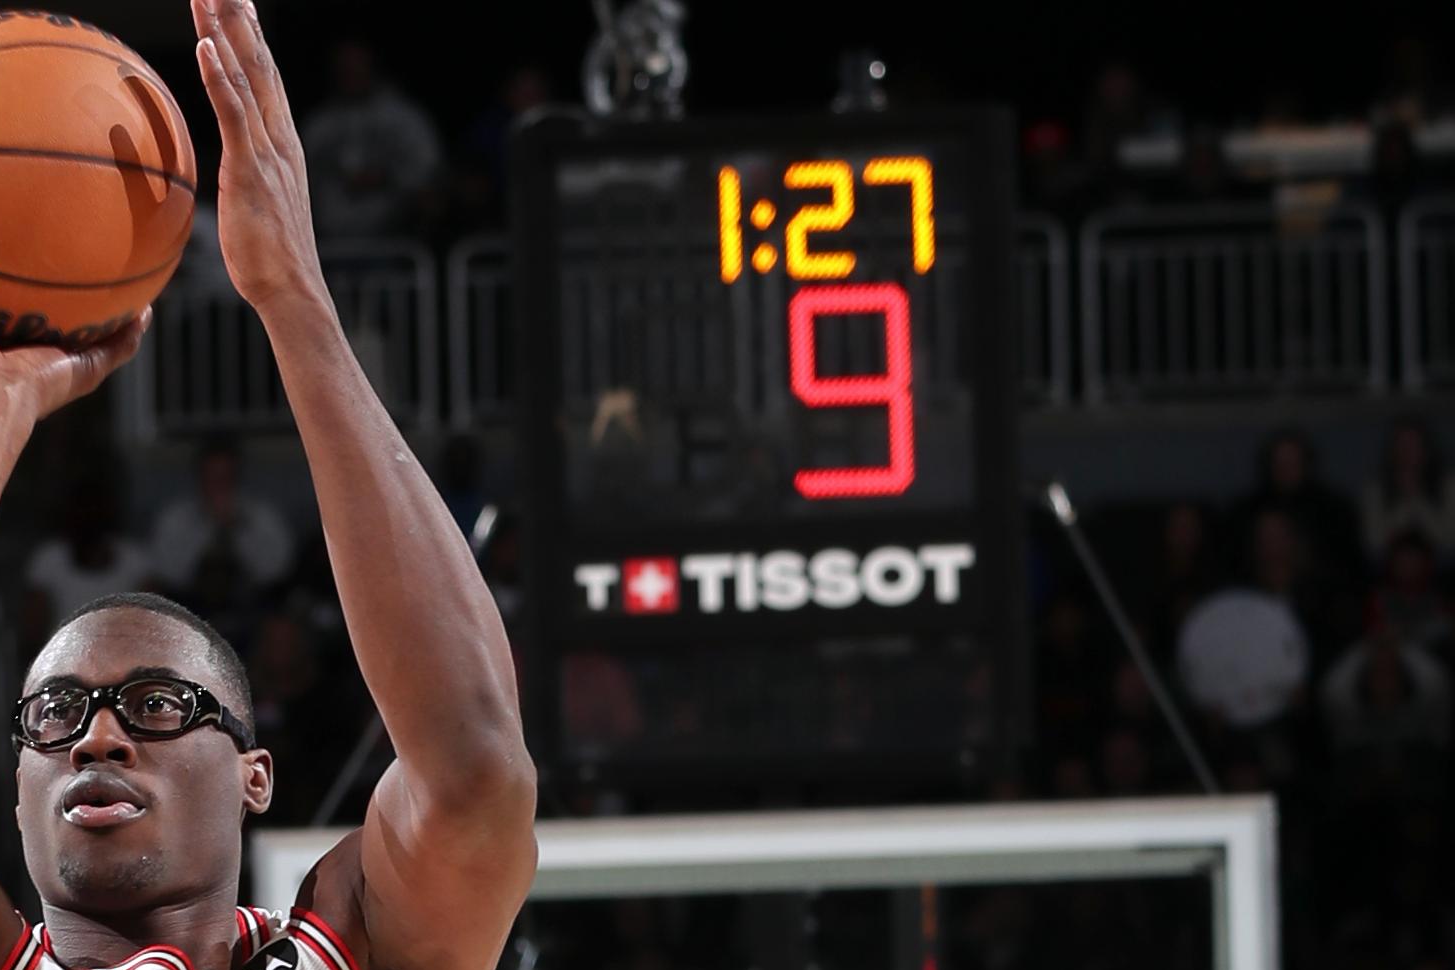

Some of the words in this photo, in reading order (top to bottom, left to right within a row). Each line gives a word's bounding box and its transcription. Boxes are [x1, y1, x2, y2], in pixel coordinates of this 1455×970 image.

[718, 156, 936, 284] 1:27
[788, 282, 916, 499] 9
[681, 543, 975, 613] TISSOT
